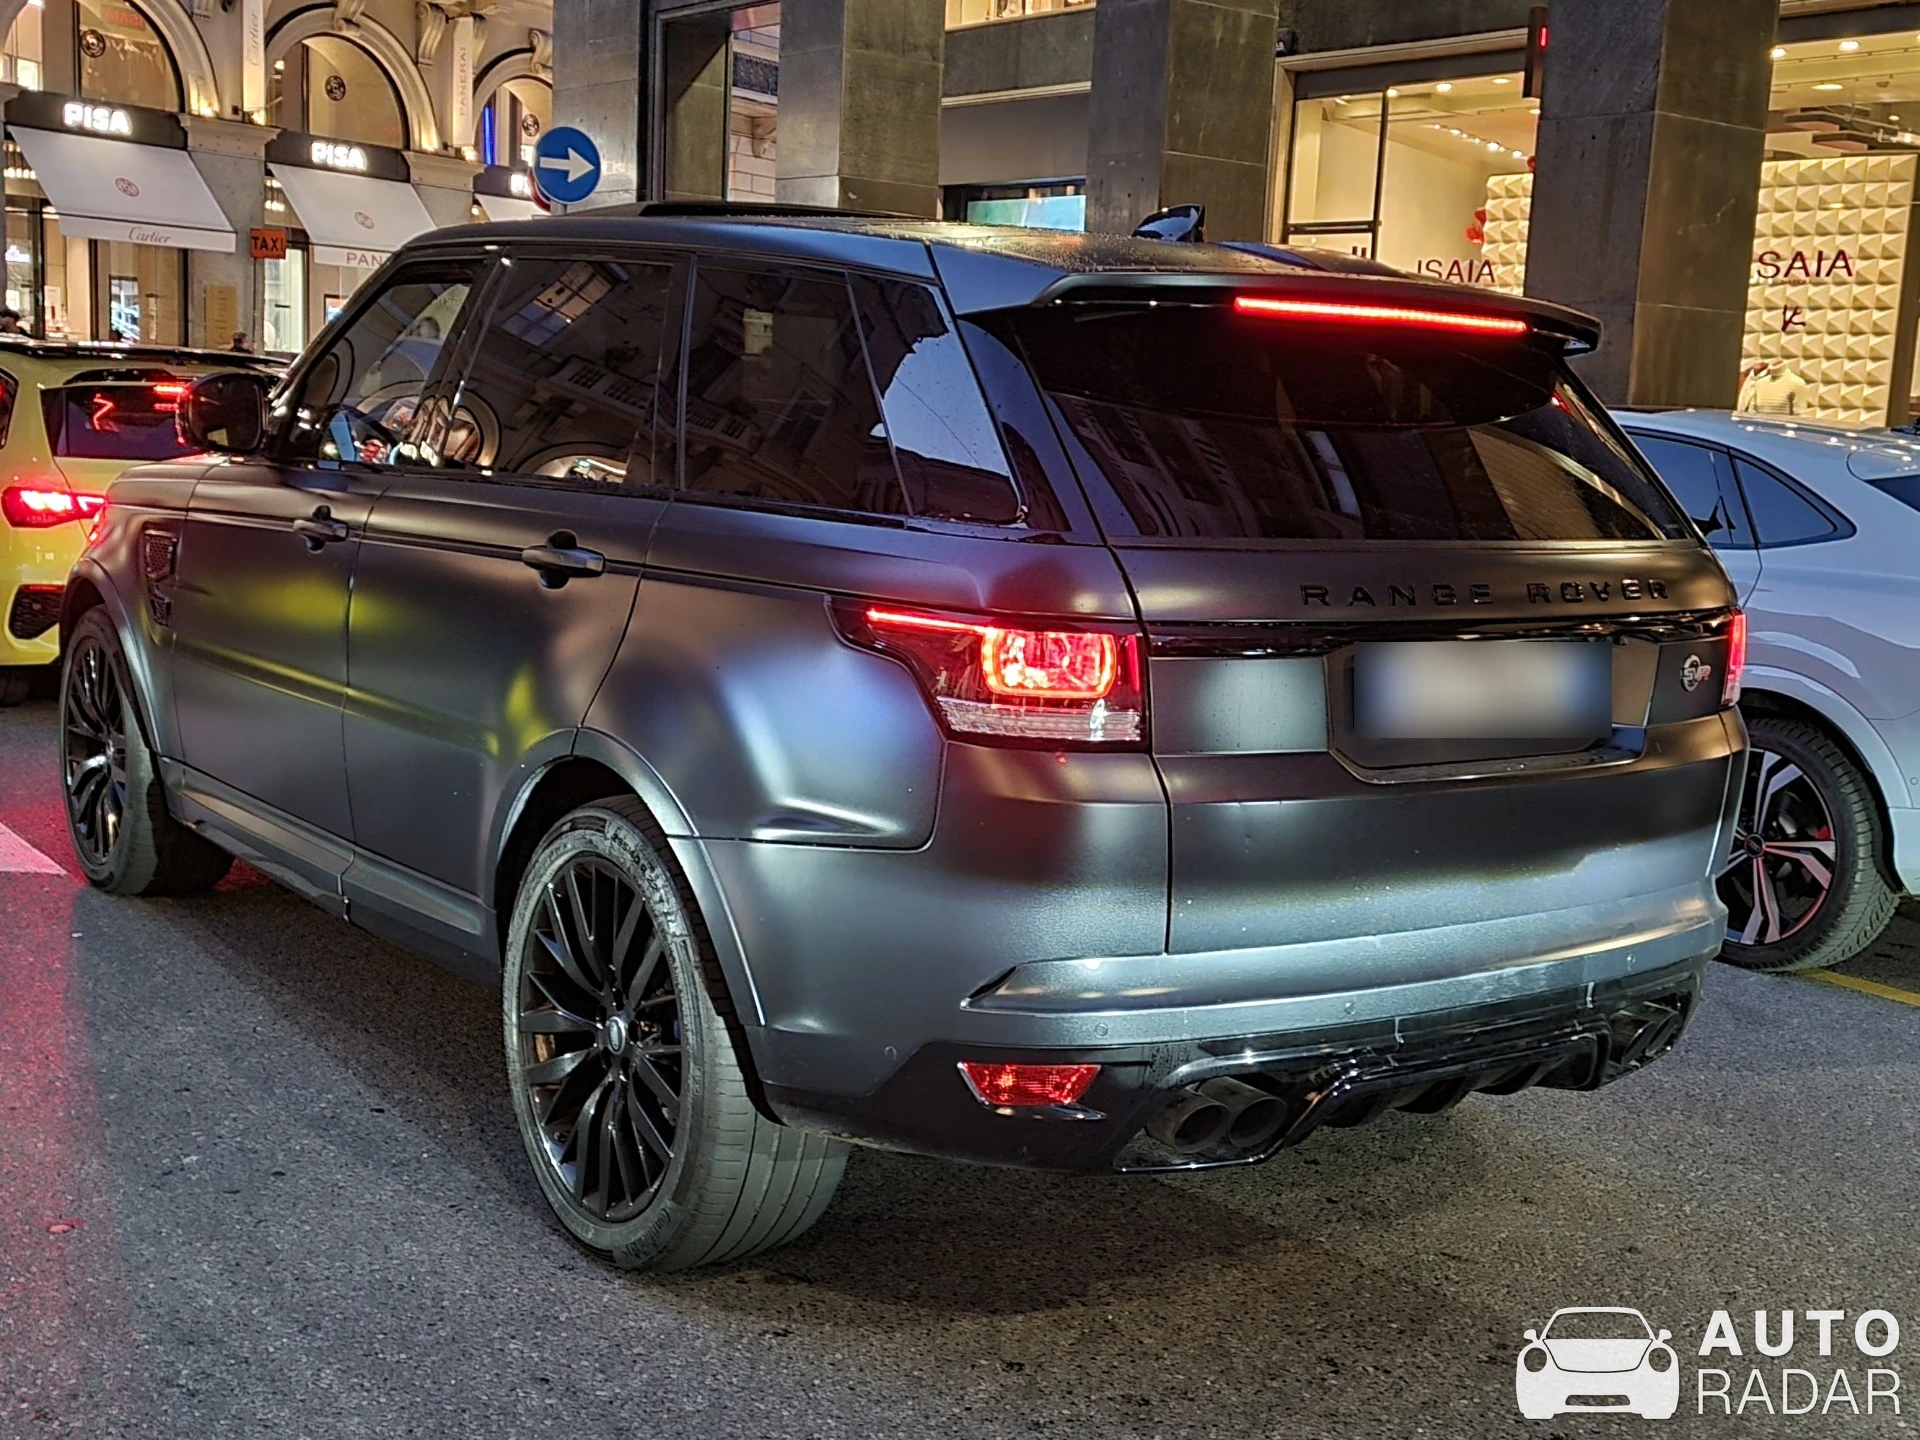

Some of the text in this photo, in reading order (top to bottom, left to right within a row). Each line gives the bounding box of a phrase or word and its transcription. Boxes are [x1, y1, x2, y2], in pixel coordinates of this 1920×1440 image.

[249, 10, 259, 67] Cartier
[459, 46, 467, 116] PANERAI
[63, 102, 132, 134] PISA
[311, 141, 367, 171] PISA
[128, 226, 172, 243] Cartier
[251, 236, 285, 252] TAXI
[1417, 259, 1496, 284] ISAIA
[1757, 249, 1853, 279] SAIA
[1300, 578, 1669, 606] RANGE ROVER
